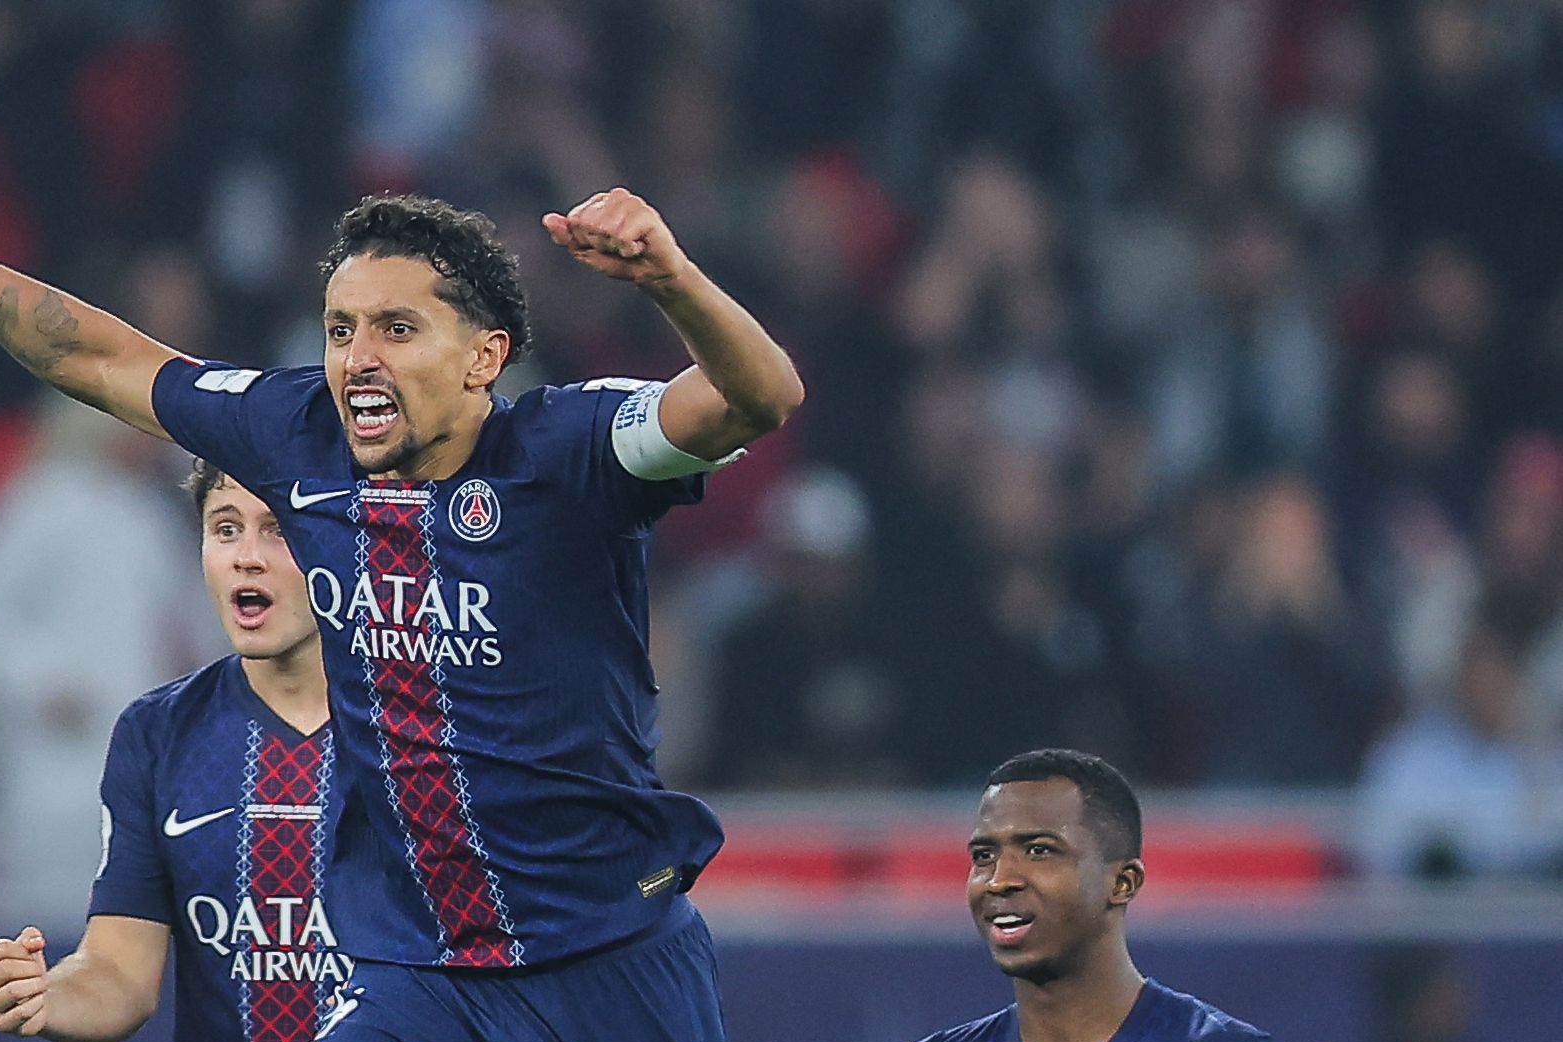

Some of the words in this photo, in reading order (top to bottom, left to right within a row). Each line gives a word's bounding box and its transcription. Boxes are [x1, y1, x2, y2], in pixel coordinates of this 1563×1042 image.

[460, 482, 492, 498] PARIS
[307, 567, 498, 631] QATAR
[351, 627, 502, 666] AIRWAYS
[187, 895, 337, 955] QATA
[231, 951, 356, 981] AIRWAY
